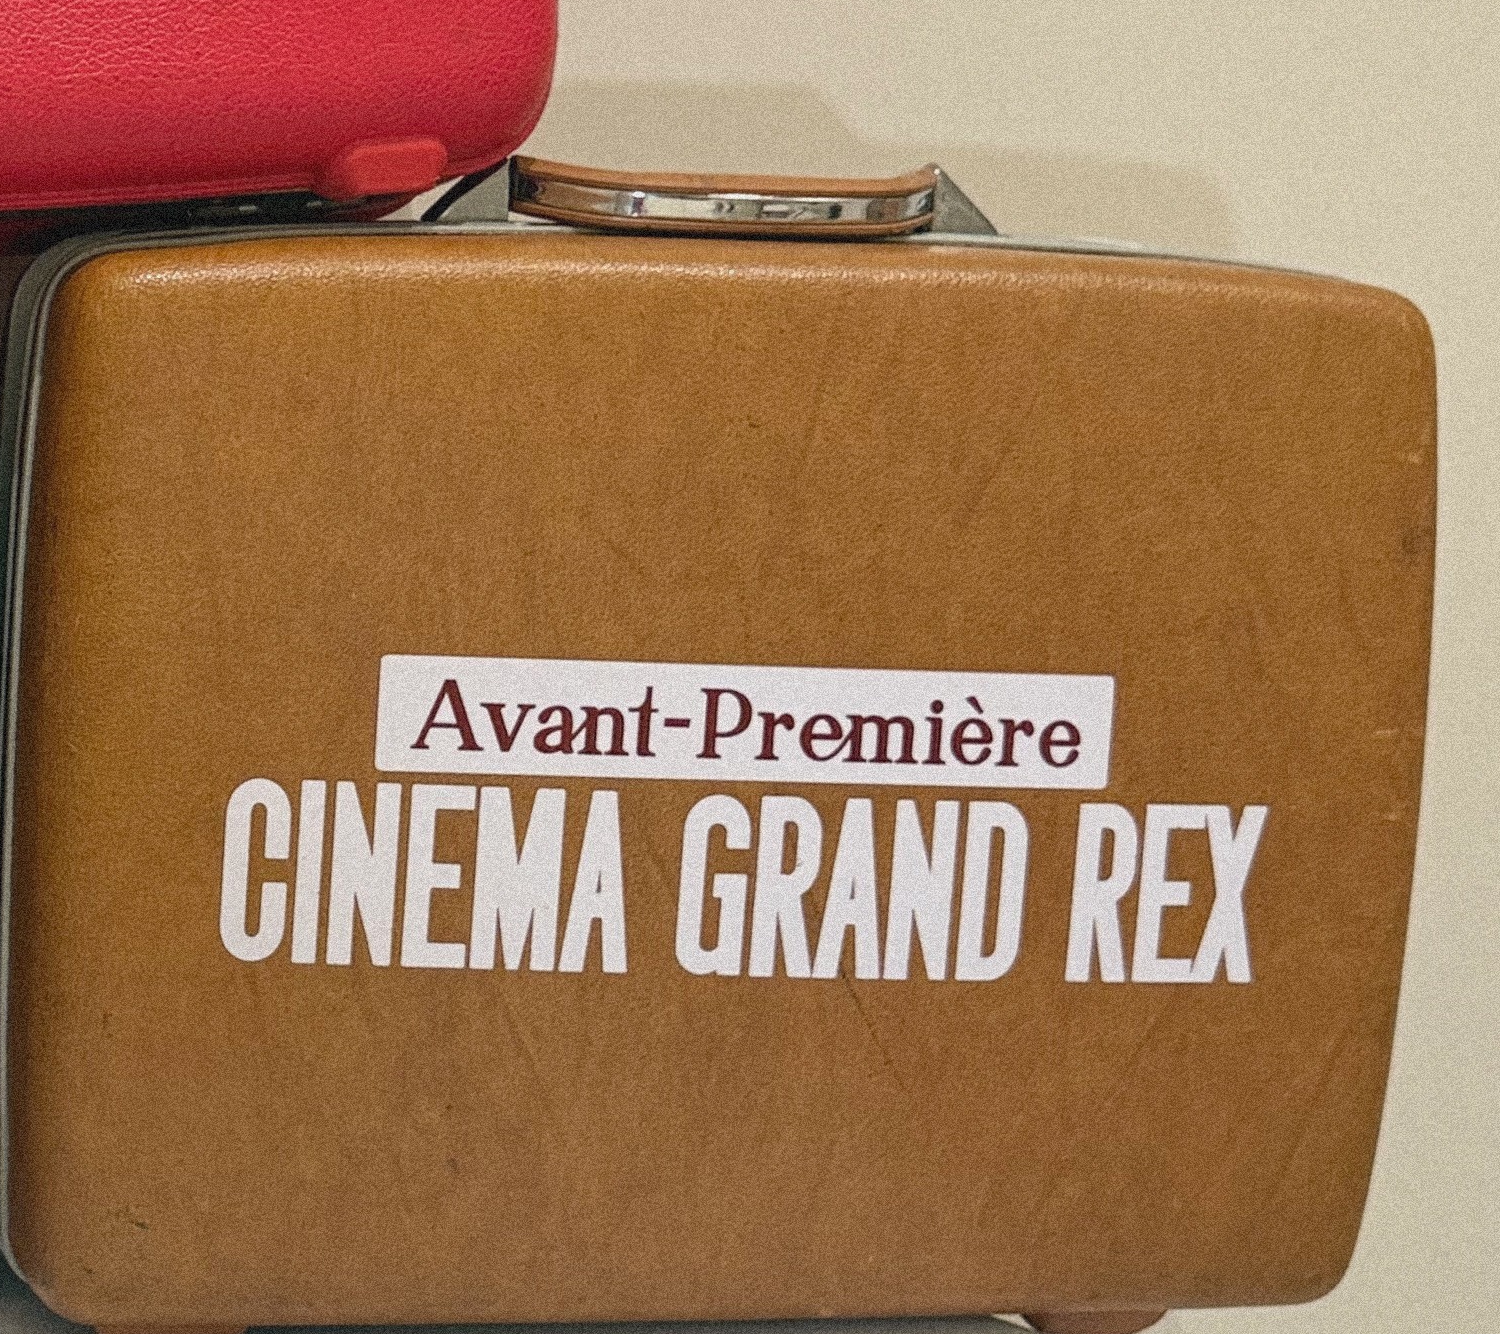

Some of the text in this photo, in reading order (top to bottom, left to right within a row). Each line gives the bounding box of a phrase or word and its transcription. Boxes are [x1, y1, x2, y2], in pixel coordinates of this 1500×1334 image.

[411, 679, 1081, 767] Avant-Première
[220, 778, 1268, 983] CINEMA GRAND REX
